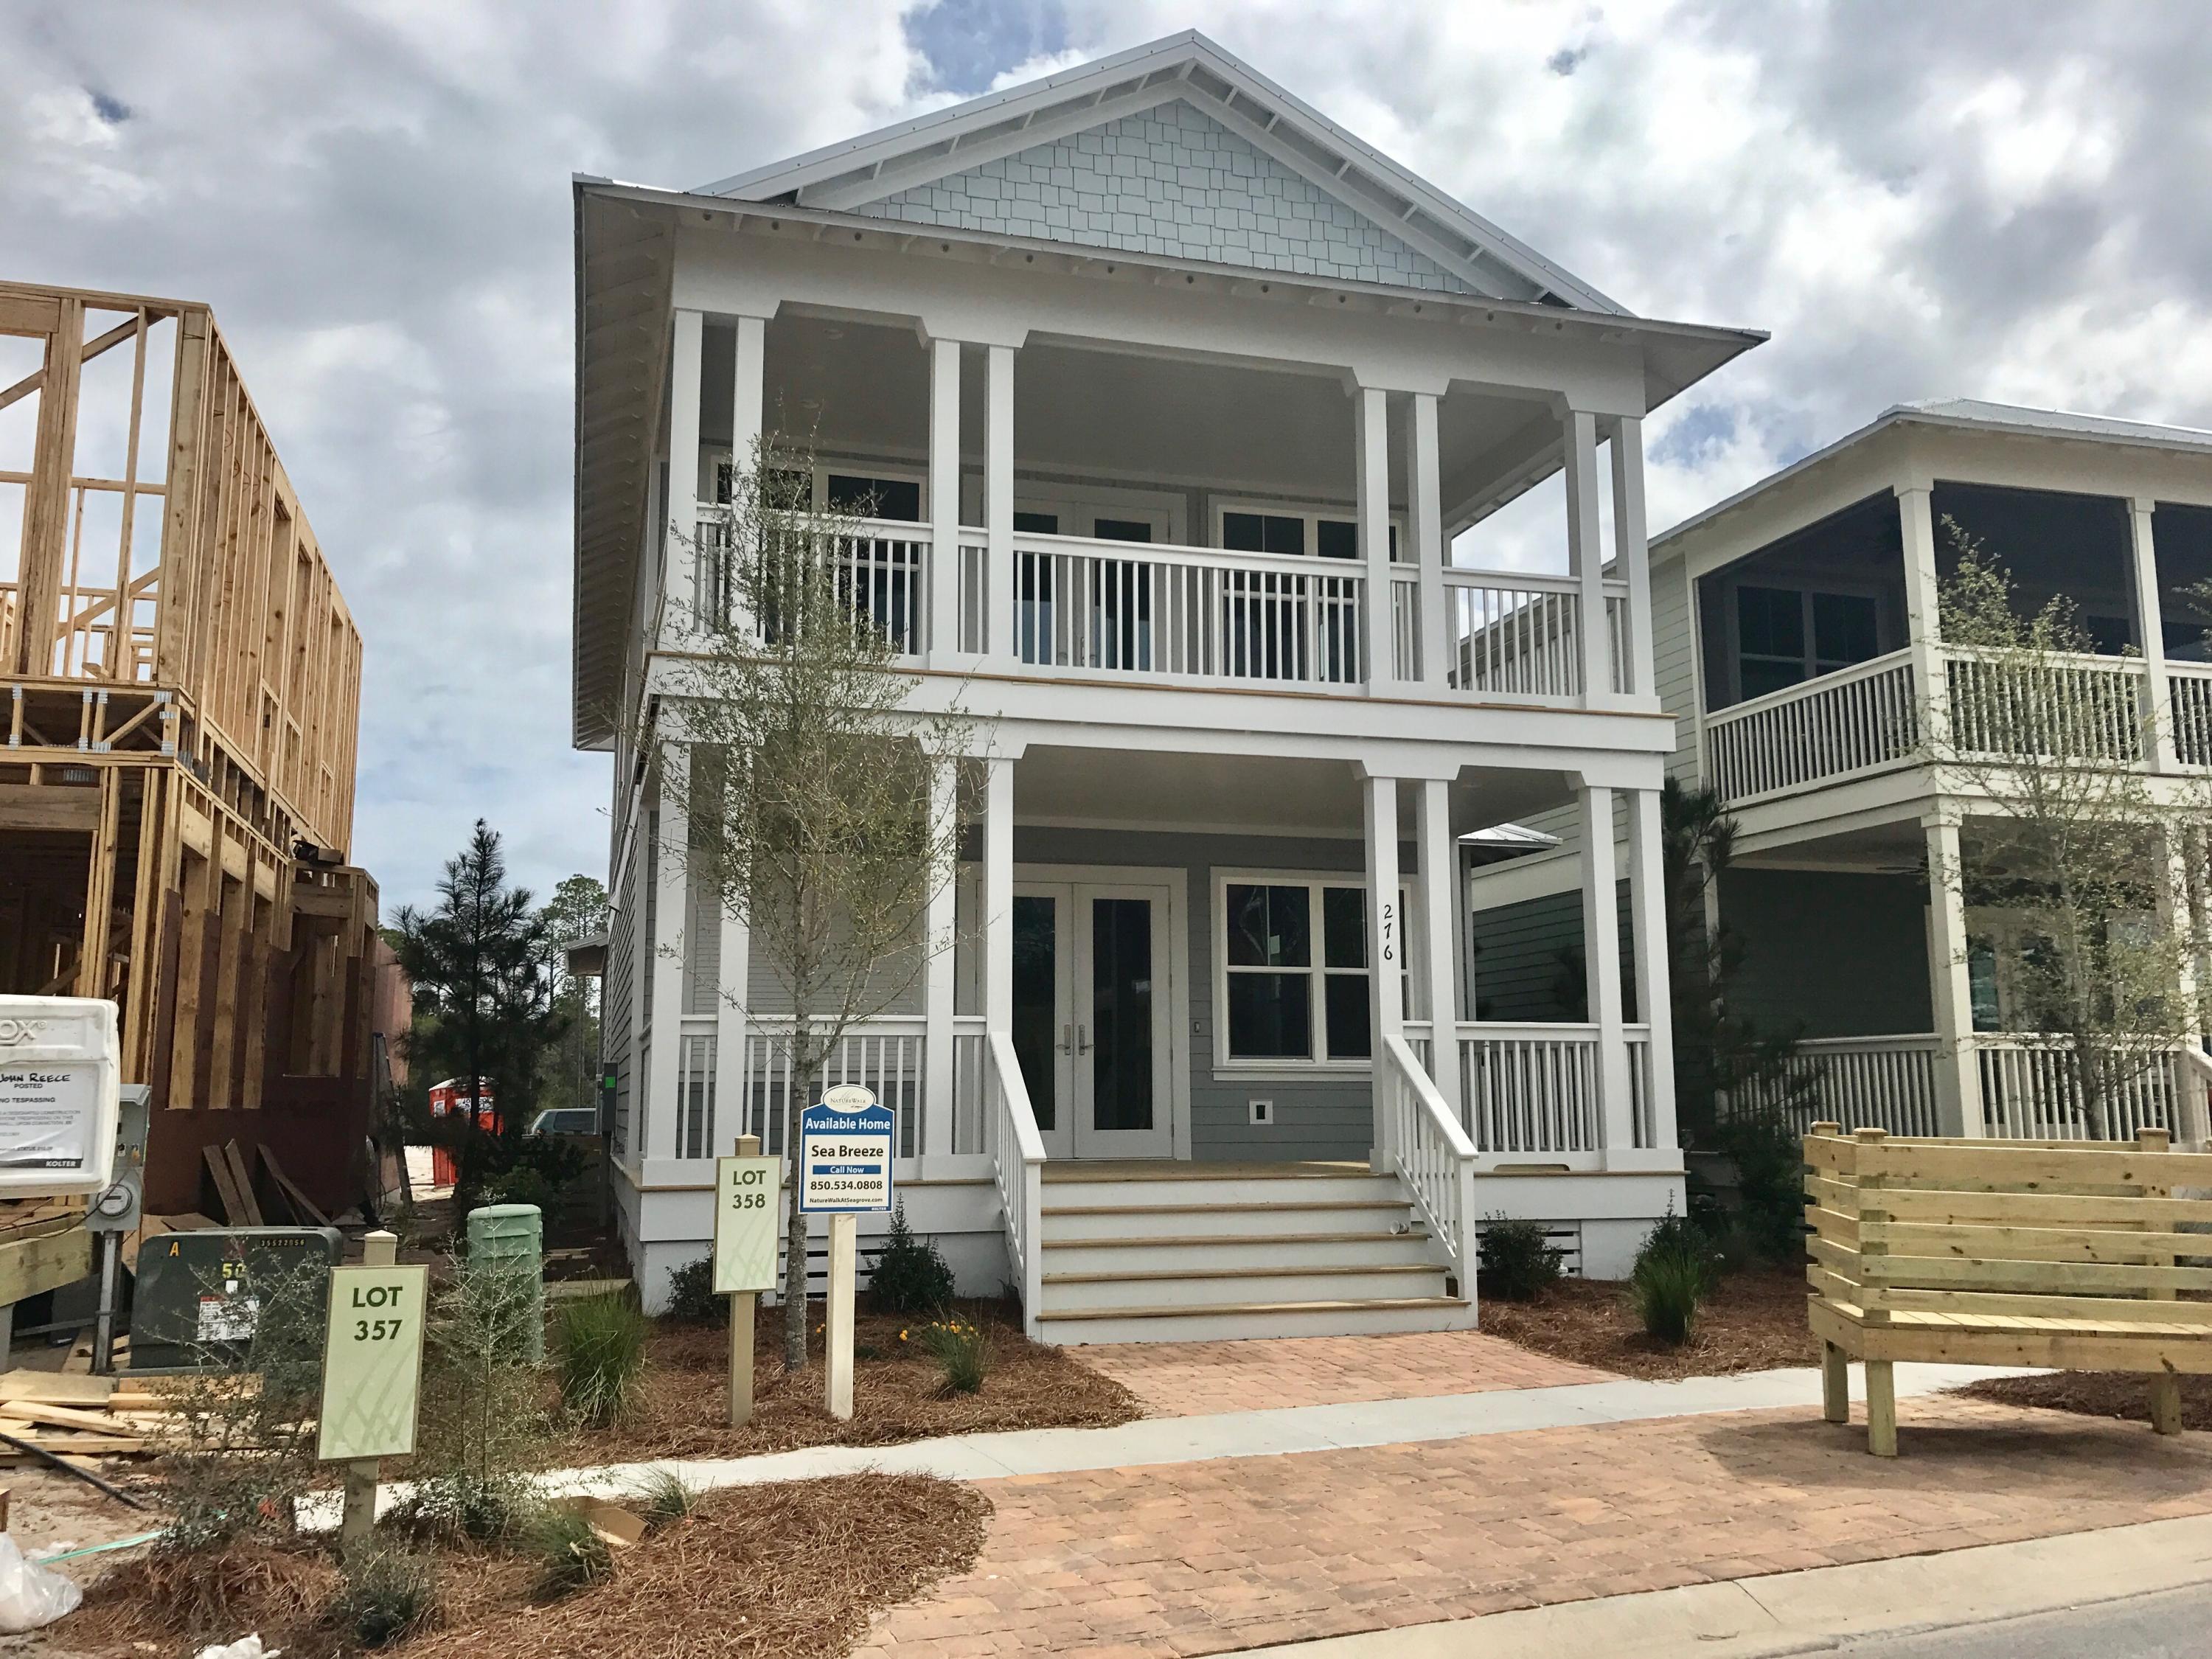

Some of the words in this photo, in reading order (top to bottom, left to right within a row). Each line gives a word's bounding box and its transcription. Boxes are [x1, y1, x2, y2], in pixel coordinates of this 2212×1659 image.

[1384, 905, 1393, 960] 276
[29, 1073, 71, 1082] REECE
[805, 1117, 856, 1129] Available
[859, 1118, 891, 1130] Home
[812, 1145, 835, 1157] Sea
[840, 1145, 883, 1157] Breeze
[733, 1170, 766, 1185] LOT
[810, 1180, 883, 1189] 850.534.0808
[732, 1193, 765, 1208] 358
[170, 1242, 179, 1256] A
[352, 1287, 403, 1307] LOT
[354, 1319, 403, 1340] 357
